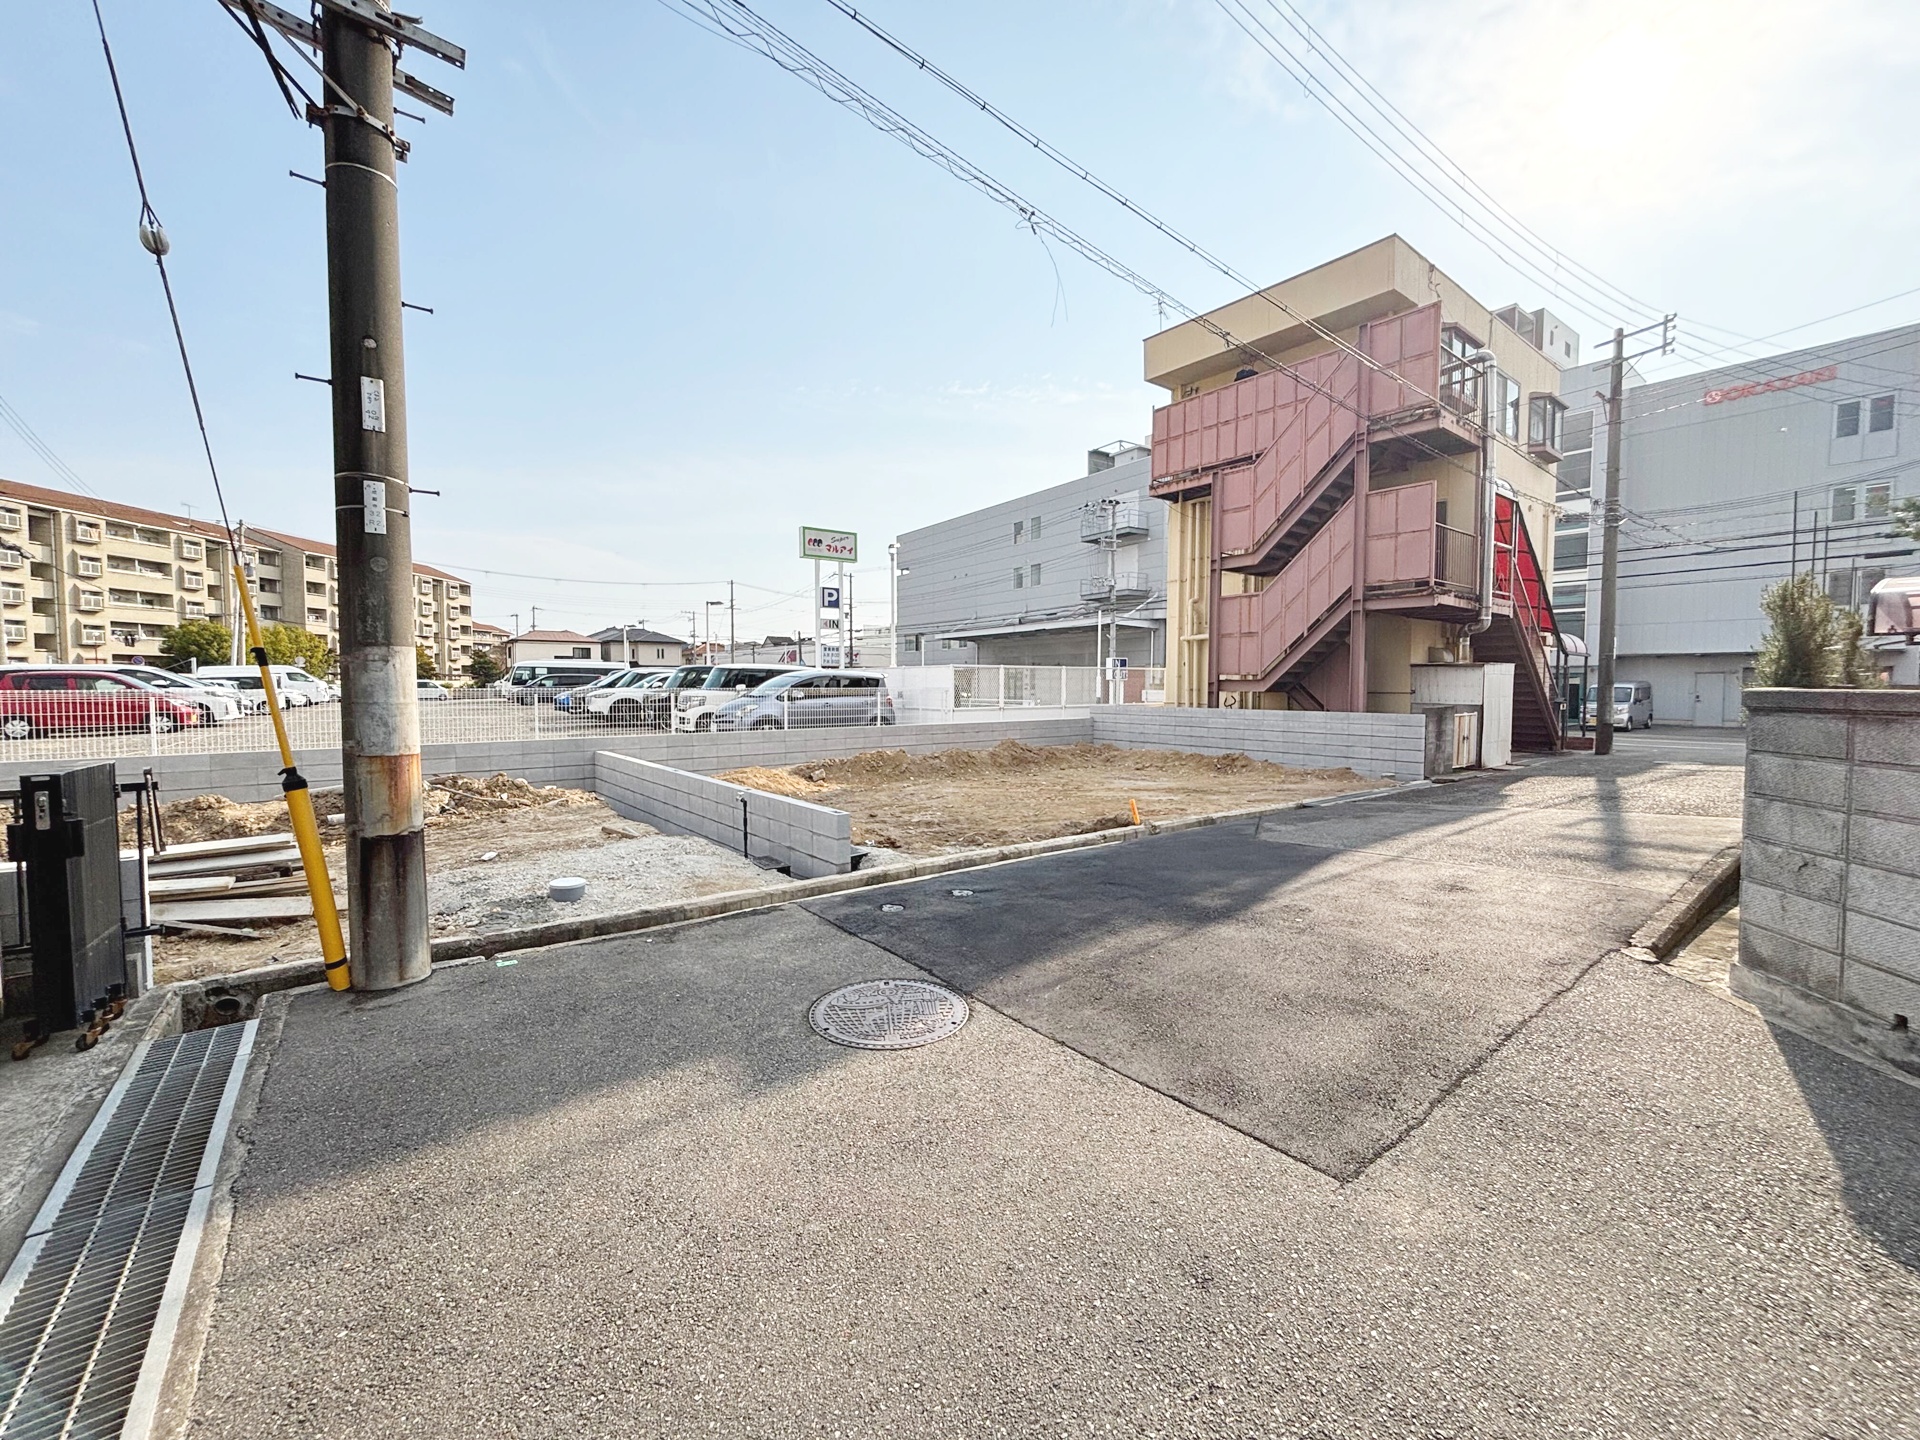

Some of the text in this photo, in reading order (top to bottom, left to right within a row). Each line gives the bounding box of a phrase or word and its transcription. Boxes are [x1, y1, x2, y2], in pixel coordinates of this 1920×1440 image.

[369, 508, 381, 517] 32
[825, 543, 854, 555] マルアイ
[823, 588, 838, 606] P
[829, 619, 839, 629] IN
